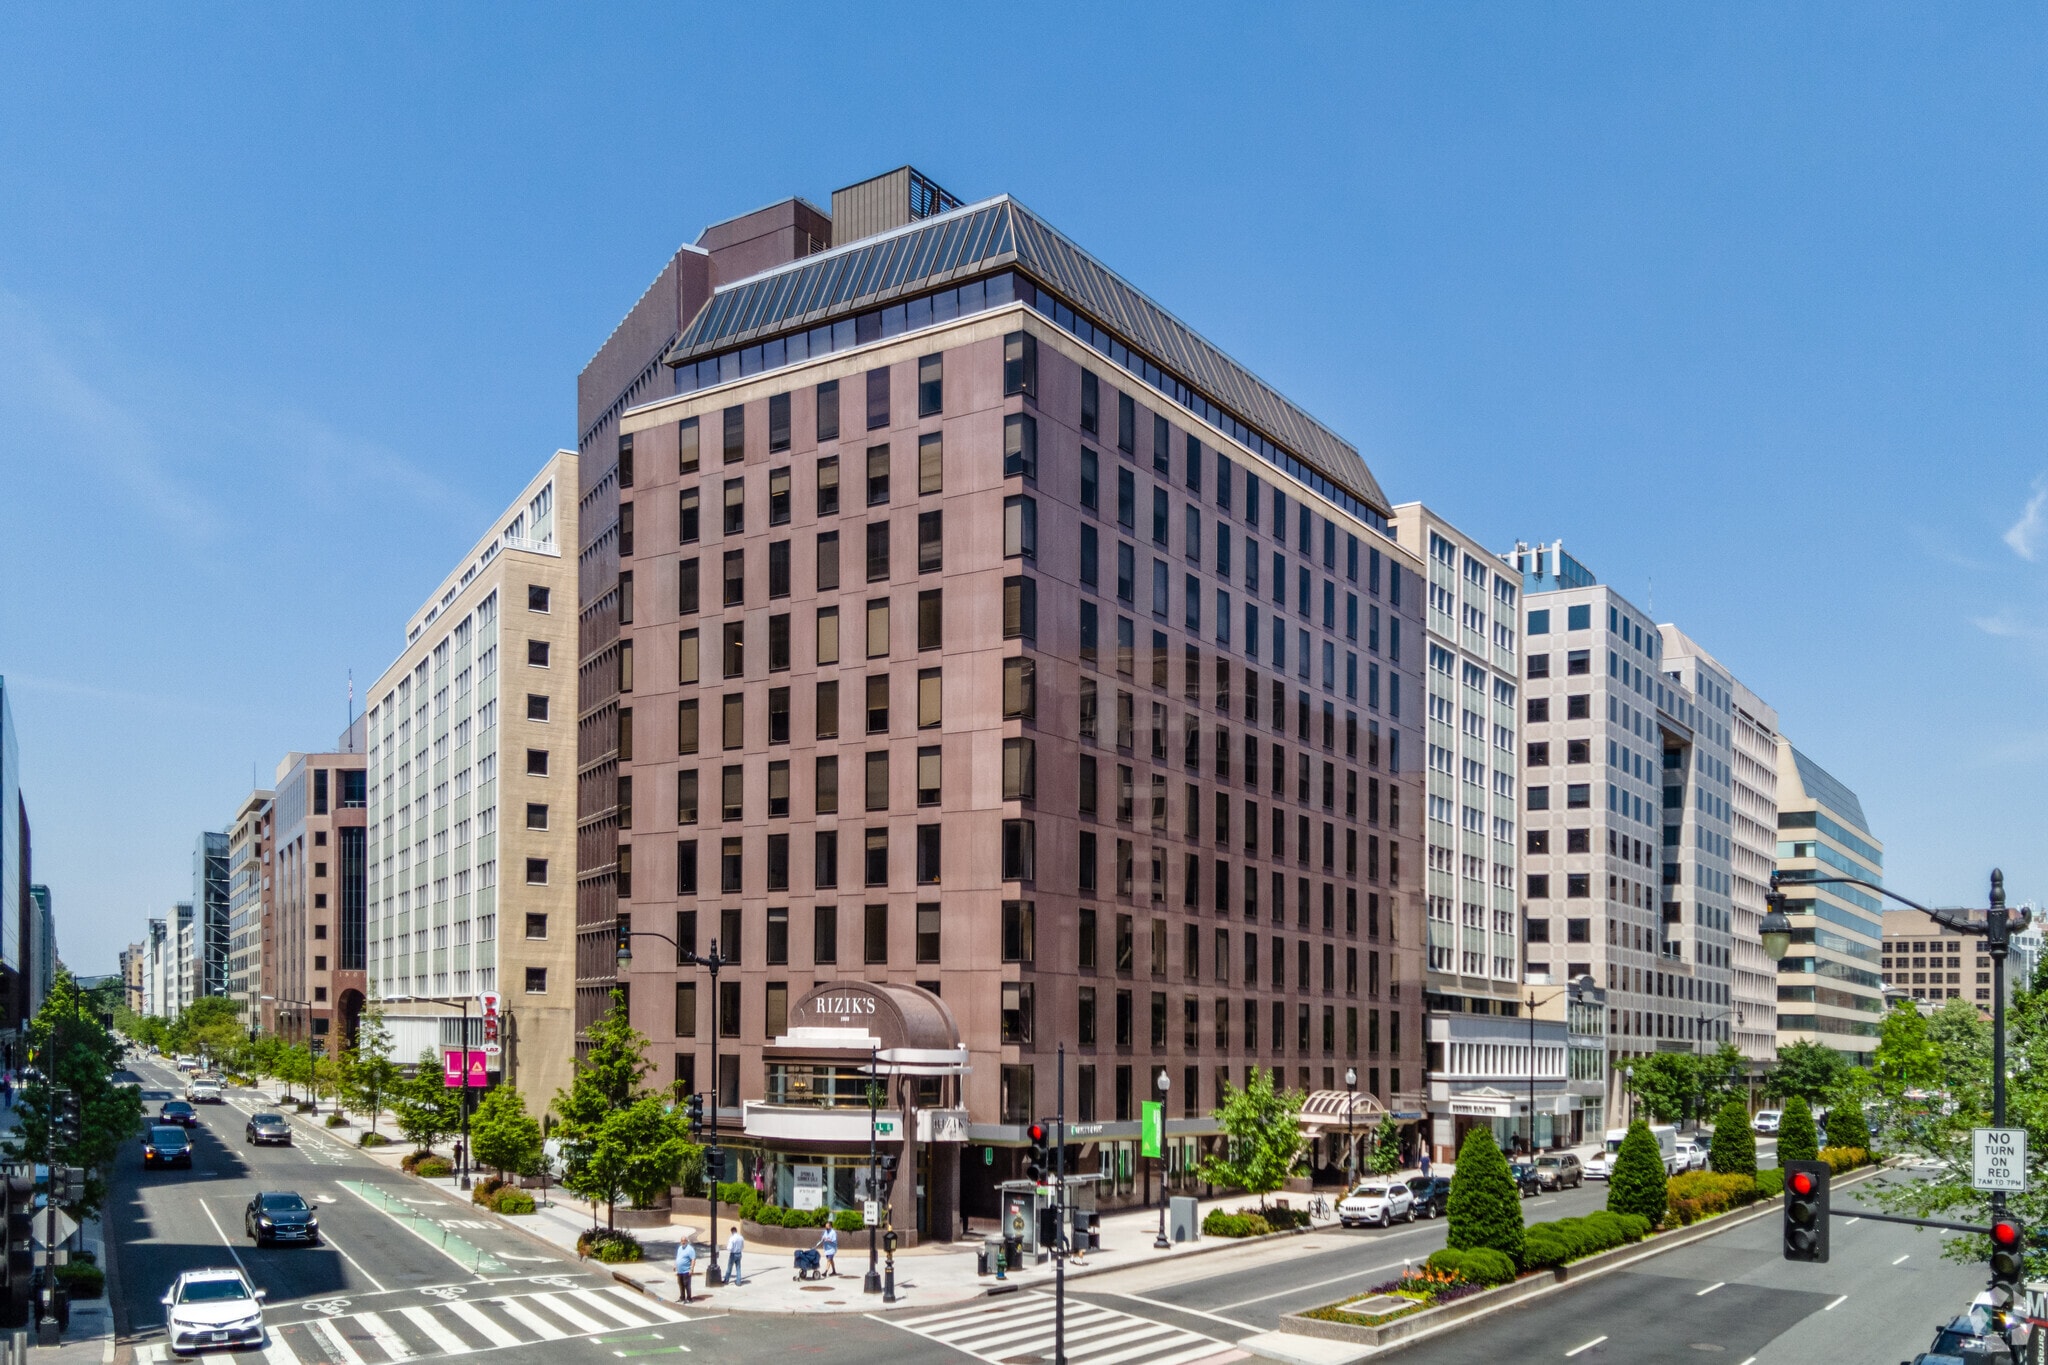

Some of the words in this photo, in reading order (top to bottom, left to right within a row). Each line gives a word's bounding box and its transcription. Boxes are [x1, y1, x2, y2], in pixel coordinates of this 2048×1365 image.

[816, 997, 876, 1014] RIZIK'S
[484, 996, 498, 1041] PARK
[446, 1053, 461, 1075] L
[1988, 1132, 2011, 1145] NO
[1985, 1145, 2015, 1156] TURN
[1991, 1156, 2008, 1167] ON
[1988, 1167, 2011, 1178] RED
[2006, 1179, 2022, 1187] 7PM
[2037, 1328, 2046, 1365] Farrag
